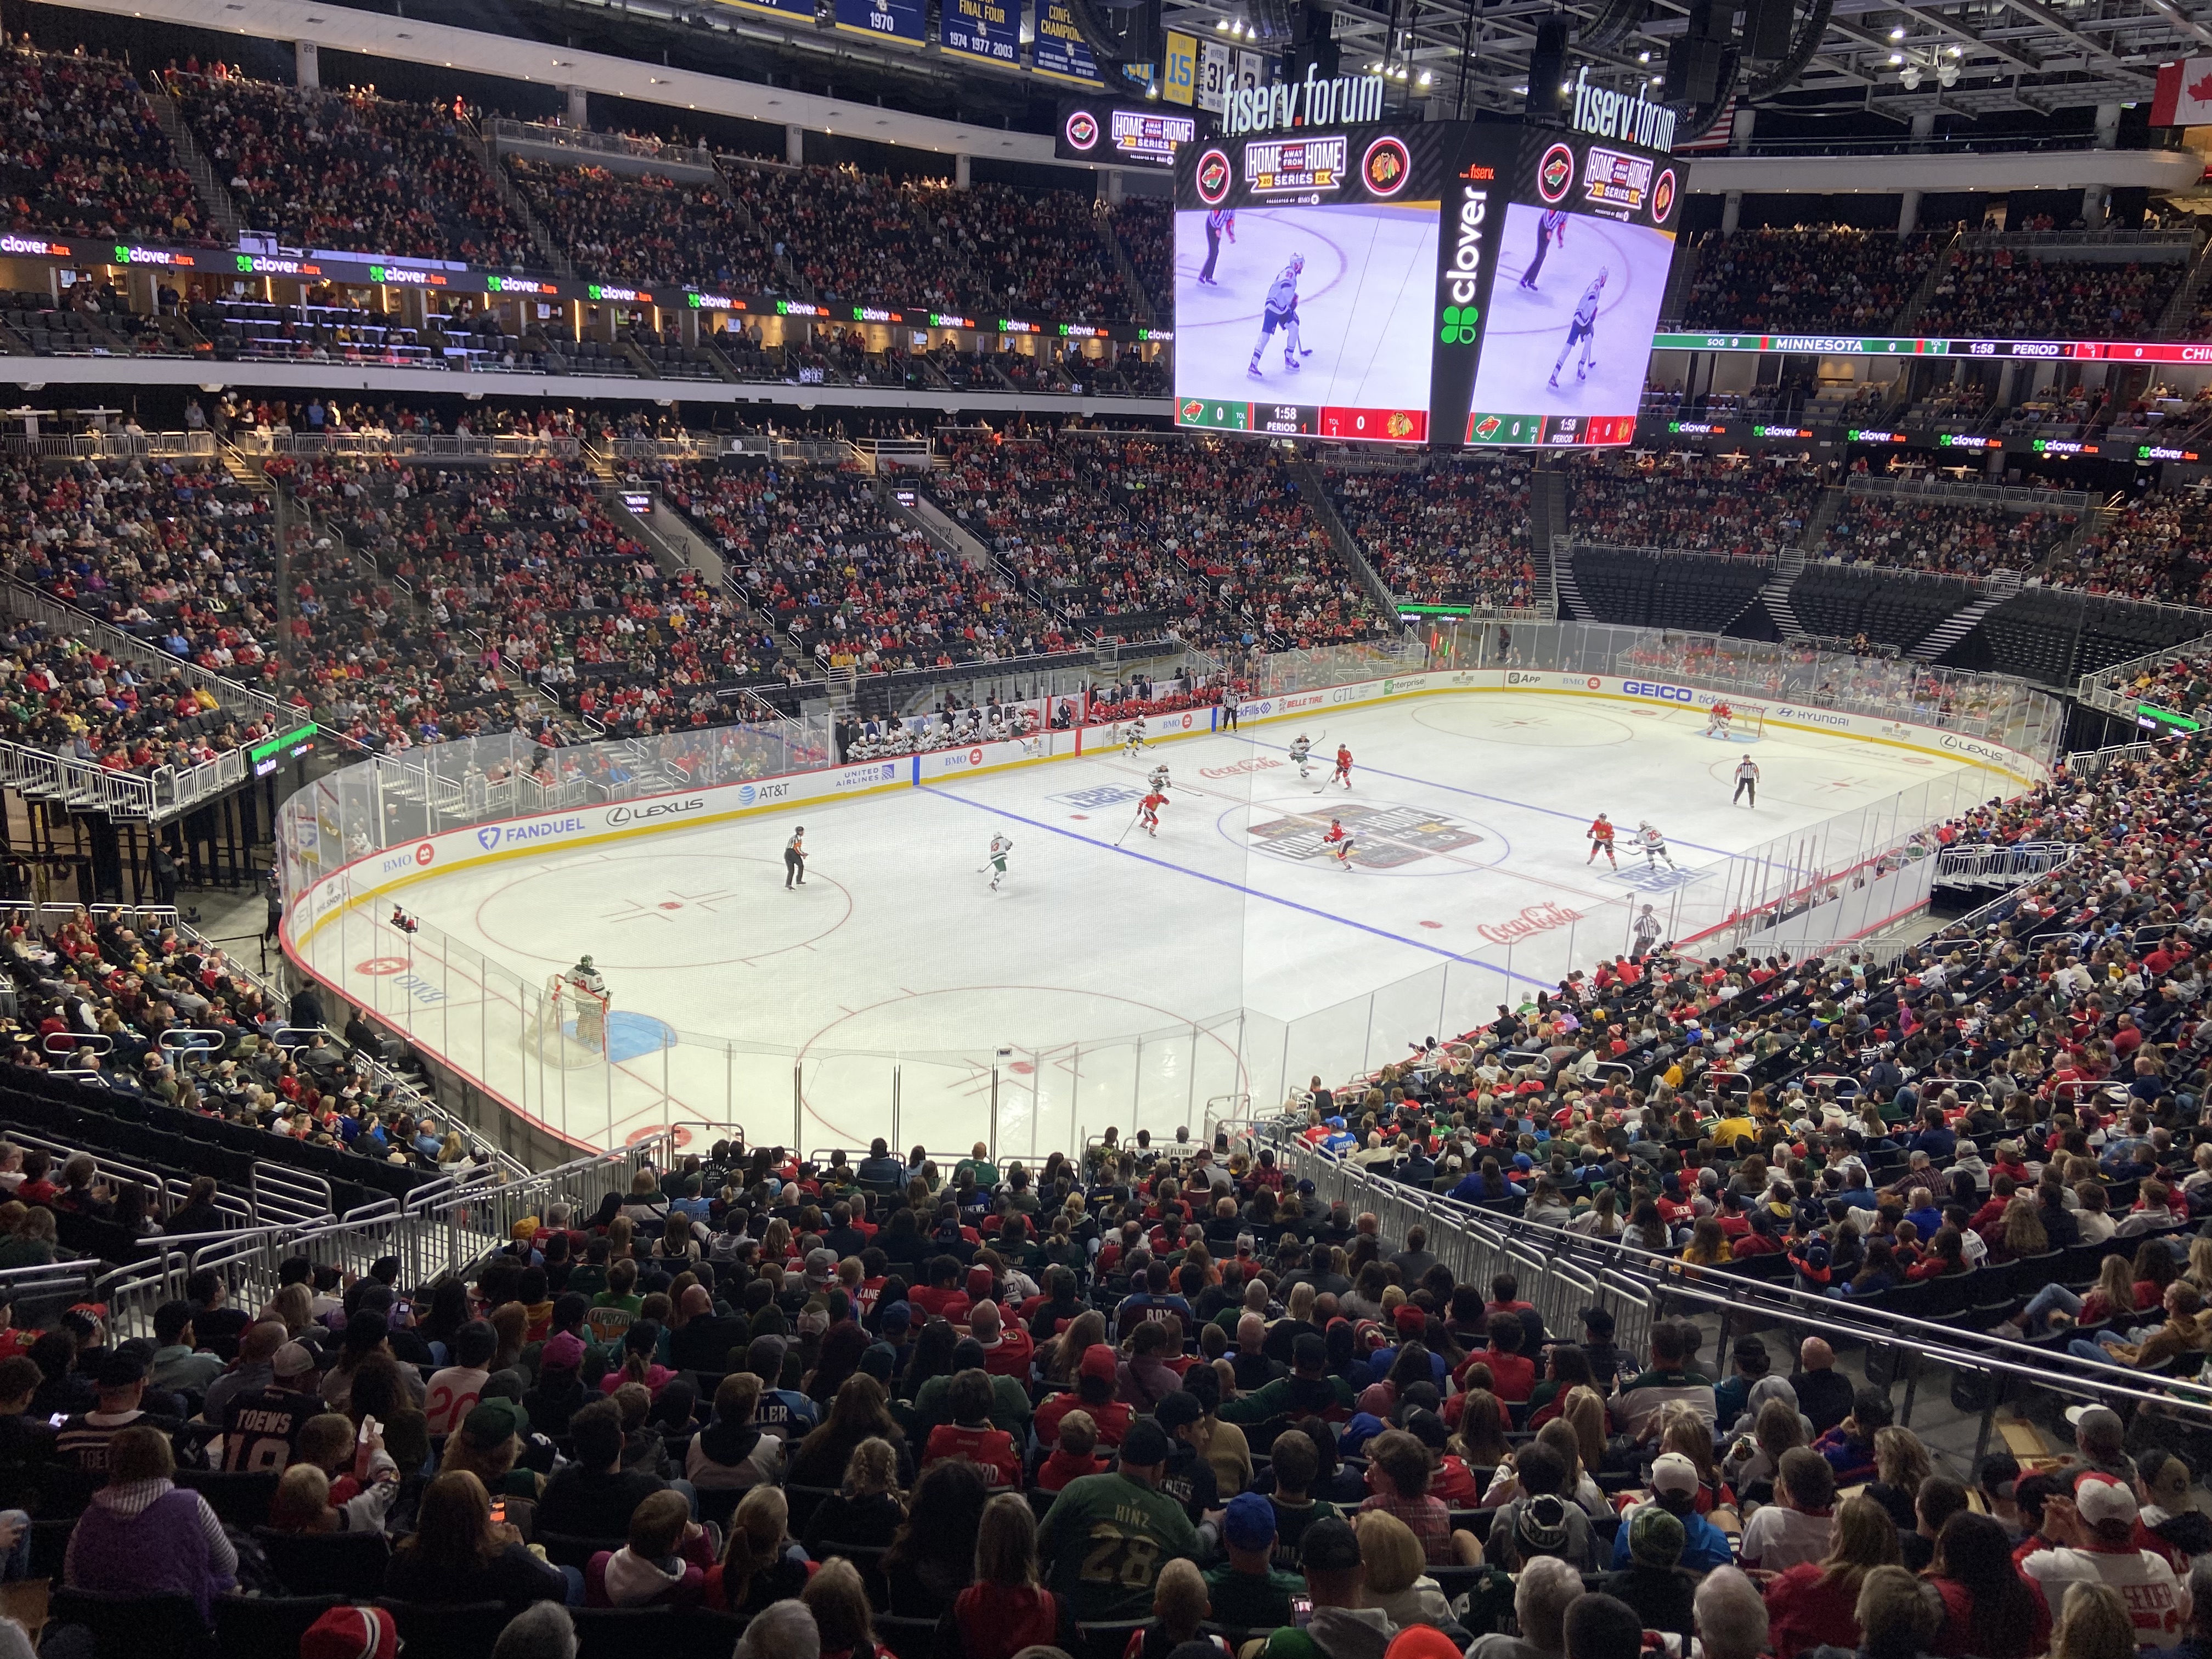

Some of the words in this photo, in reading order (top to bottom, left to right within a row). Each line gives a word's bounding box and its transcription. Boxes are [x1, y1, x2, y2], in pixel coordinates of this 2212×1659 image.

[959, 2, 983, 19] FINAL
[985, 5, 1005, 24] FOUR
[870, 11, 894, 32] 1970
[950, 31, 967, 48] 1974
[972, 37, 989, 53] 1977
[992, 42, 1013, 59] 2003
[1169, 53, 1191, 87] 15
[1207, 62, 1224, 94] 31
[1115, 115, 1144, 137] HOME
[1137, 137, 1170, 149] SERIES
[1249, 145, 1283, 176] HOME
[1284, 149, 1303, 158] AWAY
[1305, 142, 1343, 171] HOME
[1283, 157, 1304, 166] FROM
[1588, 152, 1617, 183] HOME
[1615, 163, 1629, 172] AWAY
[1274, 173, 1313, 186] SERIES
[1613, 171, 1628, 180] FROM
[1626, 160, 1651, 193] HOME
[1604, 185, 1630, 201] SERIES
[1, 236, 47, 254] clover
[1446, 185, 1487, 304] clover
[130, 246, 170, 264] clover
[252, 256, 298, 274] clover
[384, 267, 426, 284] clover
[500, 276, 539, 294] clover
[600, 286, 636, 302] clover
[699, 294, 732, 309] clover
[787, 301, 816, 315] clover
[862, 307, 889, 321] clover
[938, 313, 963, 327] clover
[1006, 320, 1030, 332] clover
[1068, 324, 1096, 336] clover
[1148, 329, 1173, 341] clover
[1707, 338, 1725, 346] SOG
[1732, 338, 1738, 347] 9
[1776, 338, 1863, 352] MINNESOTA
[1889, 342, 1897, 352] 0
[1970, 343, 1994, 354] 1:58
[2012, 344, 2058, 356] PERIOD
[2064, 346, 2071, 356] 1
[2134, 347, 2143, 357] 0
[2182, 348, 2212, 360] CHI
[1217, 407, 1223, 420] 0
[1273, 406, 1296, 420] 1:58
[1238, 420, 1244, 430] 1
[1267, 421, 1296, 433] PERIOD
[1301, 423, 1306, 433] 1
[1357, 415, 1365, 430] 0
[1512, 421, 1520, 436] 0
[1560, 417, 1576, 431] 1:58
[1679, 422, 1711, 434] clover
[1331, 426, 1336, 437] 1
[1605, 423, 1611, 437] 0
[1764, 426, 1797, 438] clover
[1859, 430, 1892, 442] clover
[1531, 434, 1536, 444] 1
[1552, 433, 1573, 443] PERIOD
[1951, 435, 1985, 447] clover
[2045, 439, 2081, 452] clover
[2149, 447, 2182, 459] clover
[1385, 678, 1425, 691] enterprise
[1562, 677, 1584, 686] BMO
[1333, 687, 1355, 703] GTL
[1623, 681, 1692, 703] GEICO
[1287, 698, 1307, 708] BELLE
[1308, 695, 1323, 704] TIRE
[1163, 719, 1180, 729] BMO
[1797, 710, 1849, 726] HYUNDAI
[1958, 741, 2004, 761] LEXUS
[945, 754, 967, 766] BMO
[844, 768, 879, 778] UNITED
[836, 775, 879, 787] AIRLINES
[759, 783, 789, 799] AT&T
[1064, 787, 1120, 800] BUD
[1071, 789, 1147, 808] LIGHT
[634, 802, 704, 820] LEXUS
[1356, 808, 1444, 831] HOME
[506, 818, 585, 842] FANDUEL
[383, 854, 412, 873] BMO
[1615, 864, 1671, 882] BUD
[1633, 867, 1705, 892] LIGHT
[393, 975, 450, 1003] BMO
[856, 1288, 881, 1300] KANE
[236, 1408, 292, 1434] TOEWS
[1115, 1504, 1150, 1528] HINZ
[1079, 1523, 1160, 1588] 28
